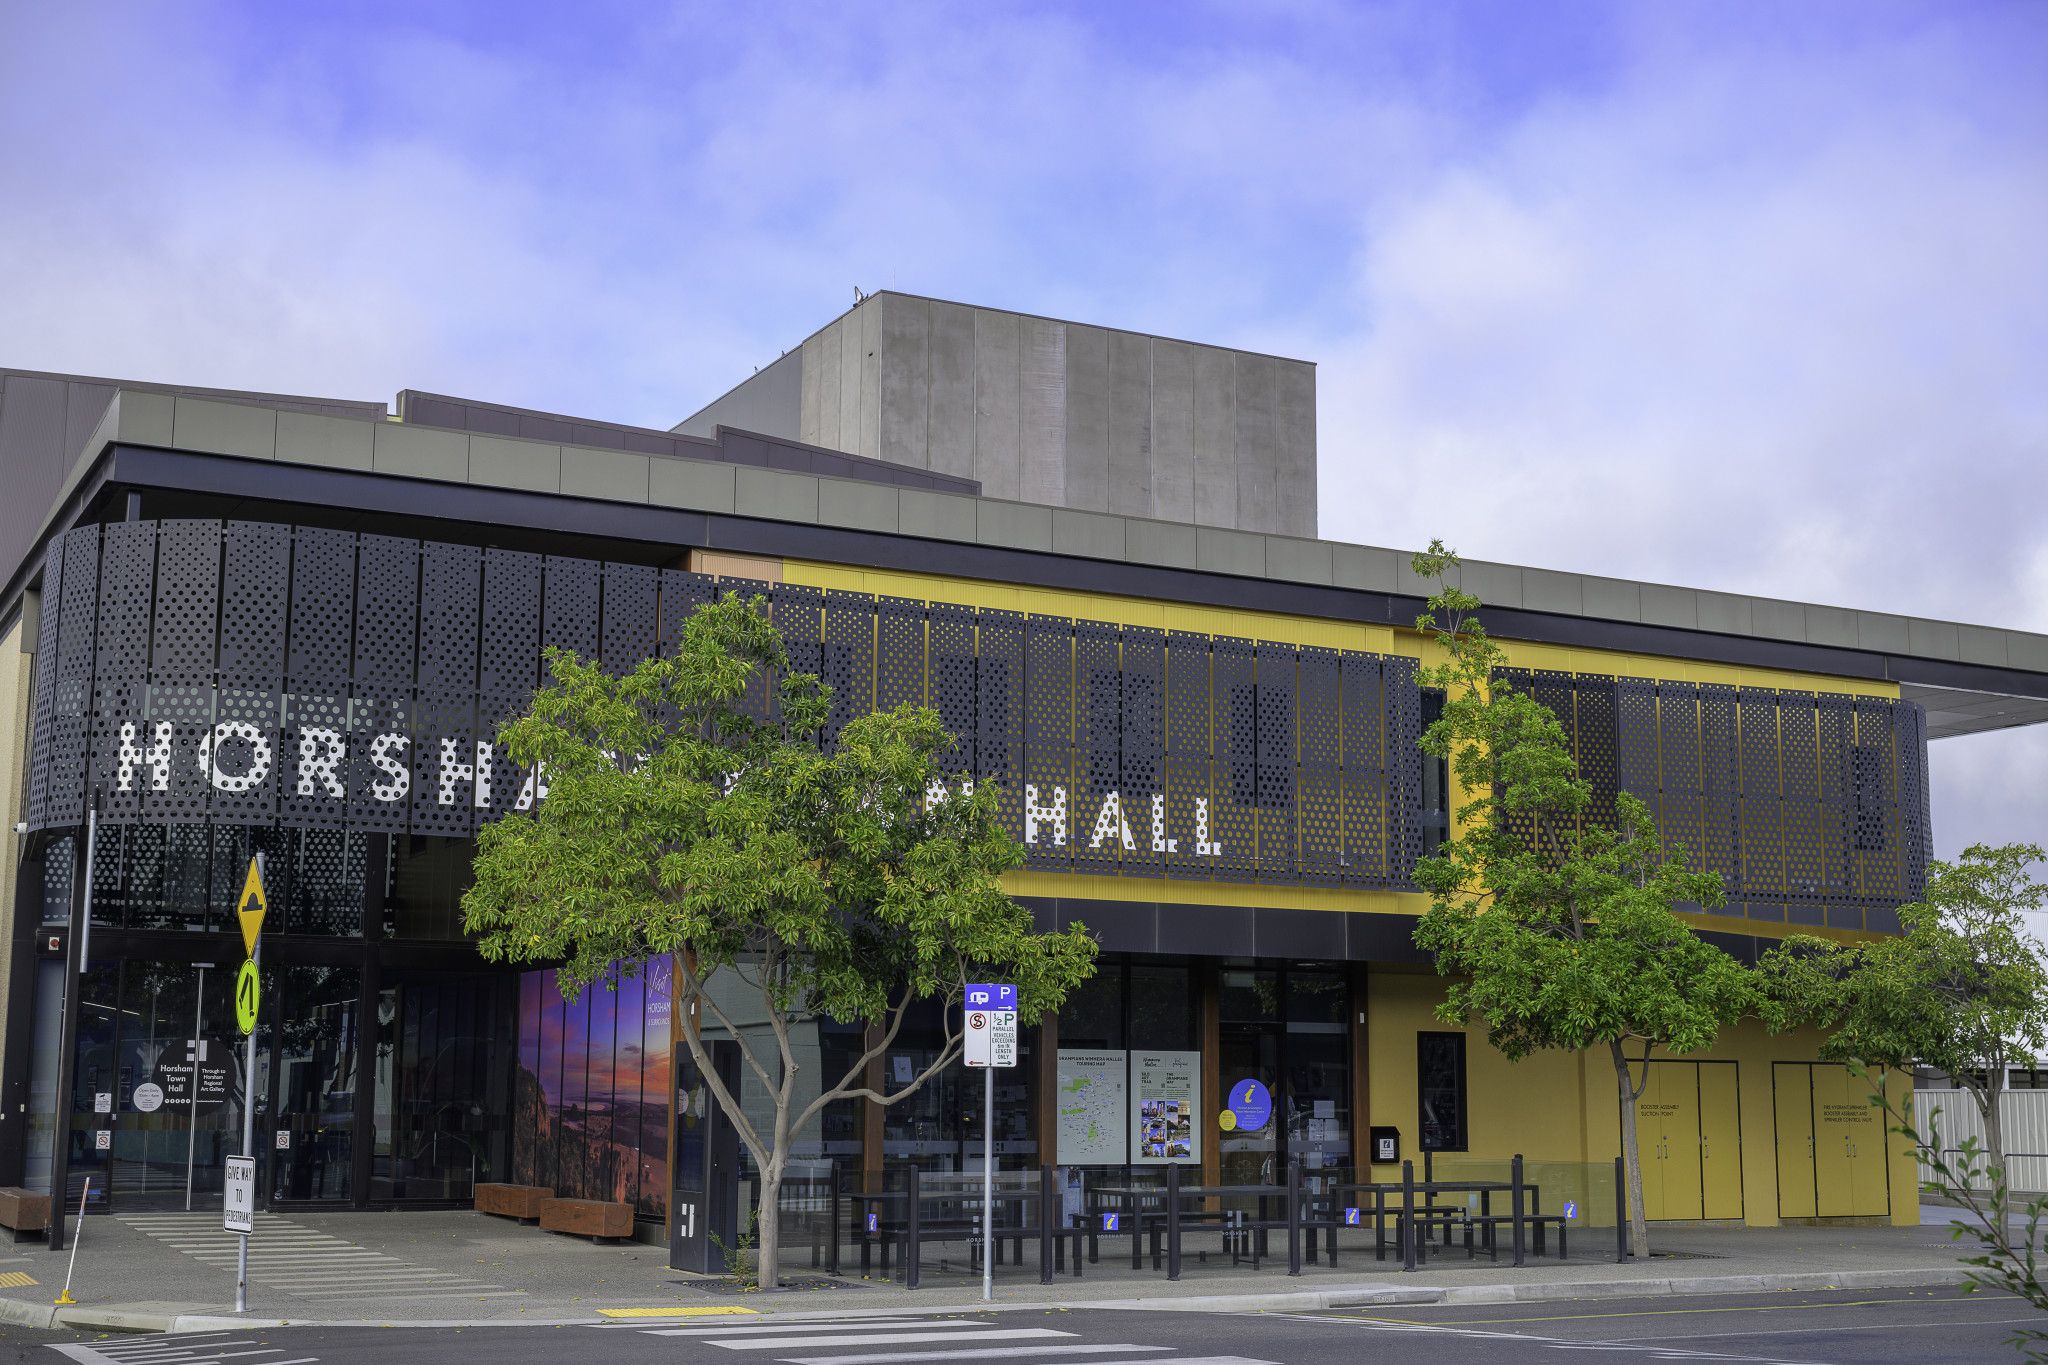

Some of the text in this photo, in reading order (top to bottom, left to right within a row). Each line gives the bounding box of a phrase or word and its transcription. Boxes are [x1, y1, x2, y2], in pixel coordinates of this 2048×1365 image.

[118, 721, 653, 812] HORSH
[1025, 784, 1221, 856] HALL
[1000, 986, 1011, 1000] P
[647, 1002, 671, 1013] HORSHAM
[160, 1064, 193, 1072] Horsham
[166, 1074, 186, 1082] Town
[168, 1084, 184, 1092] Hall
[228, 1165, 253, 1181] GIVE WAY
[235, 1188, 243, 1203] TO
[226, 1209, 251, 1225] PEDESTRIANS
